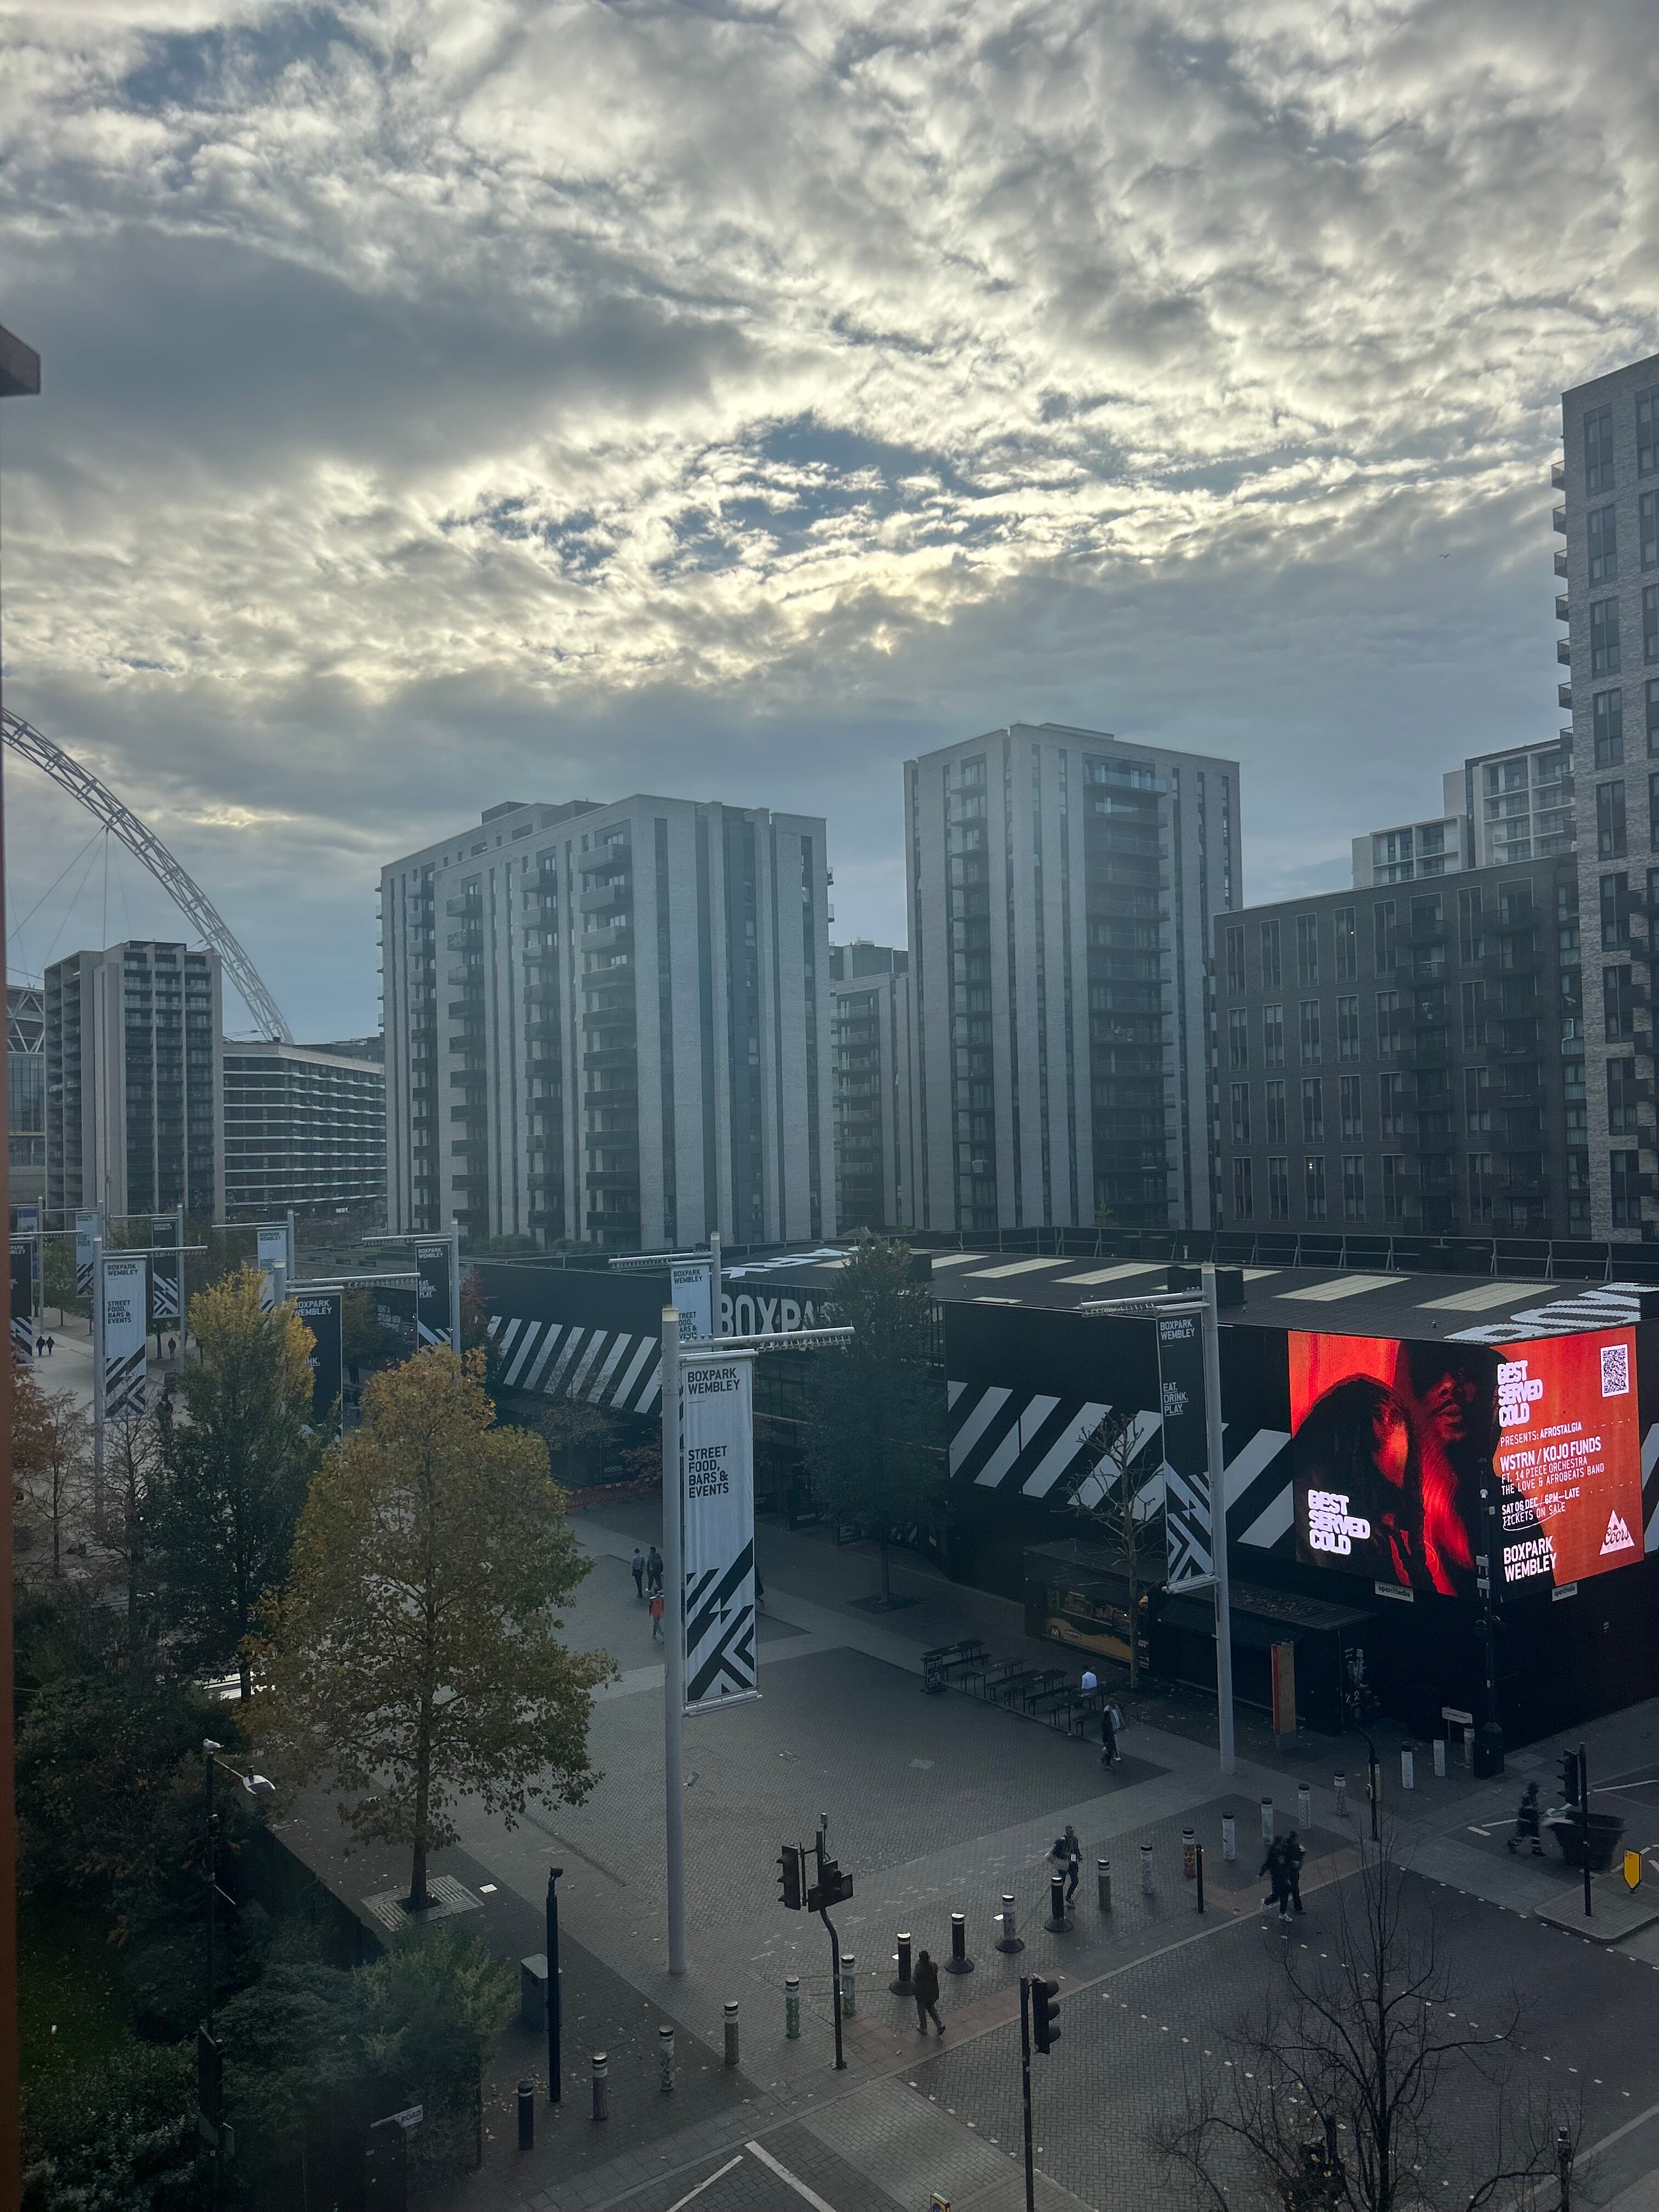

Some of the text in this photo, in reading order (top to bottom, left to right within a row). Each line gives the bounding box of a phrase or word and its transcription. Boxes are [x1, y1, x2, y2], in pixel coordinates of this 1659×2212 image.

[673, 1268, 701, 1277] BOXPARK
[674, 1275, 703, 1284] WEMBLEY
[678, 1311, 697, 1320] TREET
[721, 1293, 837, 1337] BOXPA
[1160, 1318, 1193, 1331] BOXPARK
[679, 1331, 698, 1340] VENTS
[1160, 1328, 1195, 1341] WEMBLEY
[687, 1367, 737, 1383] BOXPARK
[1497, 1359, 1528, 1385] BEST
[688, 1379, 741, 1395] WEMBLEY
[1163, 1382, 1178, 1392] EAT.
[1498, 1378, 1543, 1407] SERVED
[1164, 1391, 1189, 1404] DRINK.
[1164, 1403, 1183, 1415] PLAY.
[1499, 1402, 1530, 1427] COLD
[1500, 1421, 1582, 1447] PRESENTS: AFROSTALGIA
[688, 1445, 727, 1461] STREET
[1500, 1449, 1535, 1472] WSTRN
[1543, 1443, 1568, 1463] KOJO
[1570, 1436, 1601, 1457] FUNDS
[689, 1459, 720, 1474] FOOD,
[1502, 1456, 1588, 1484] FT. 14 PIECE ORCHESTRA
[689, 1470, 729, 1486] BARS &
[1502, 1463, 1605, 1496] THE LOVE & AFROBEATS BAND
[689, 1482, 729, 1499] EVENTS
[1308, 1489, 1350, 1515] BEST
[1502, 1504, 1514, 1515] SAT
[1515, 1500, 1524, 1512] 06
[1525, 1497, 1539, 1509] DEC
[1502, 1501, 1566, 1527] TICKETS ON SALE
[1308, 1509, 1370, 1539] SERVED
[1309, 1528, 1351, 1555] COLD
[1603, 1527, 1630, 1546] Coors
[1503, 1535, 1554, 1565] BOXPARK
[1504, 1552, 1558, 1583] WEMBLEY
[400, 2110, 421, 2122] ROAD
